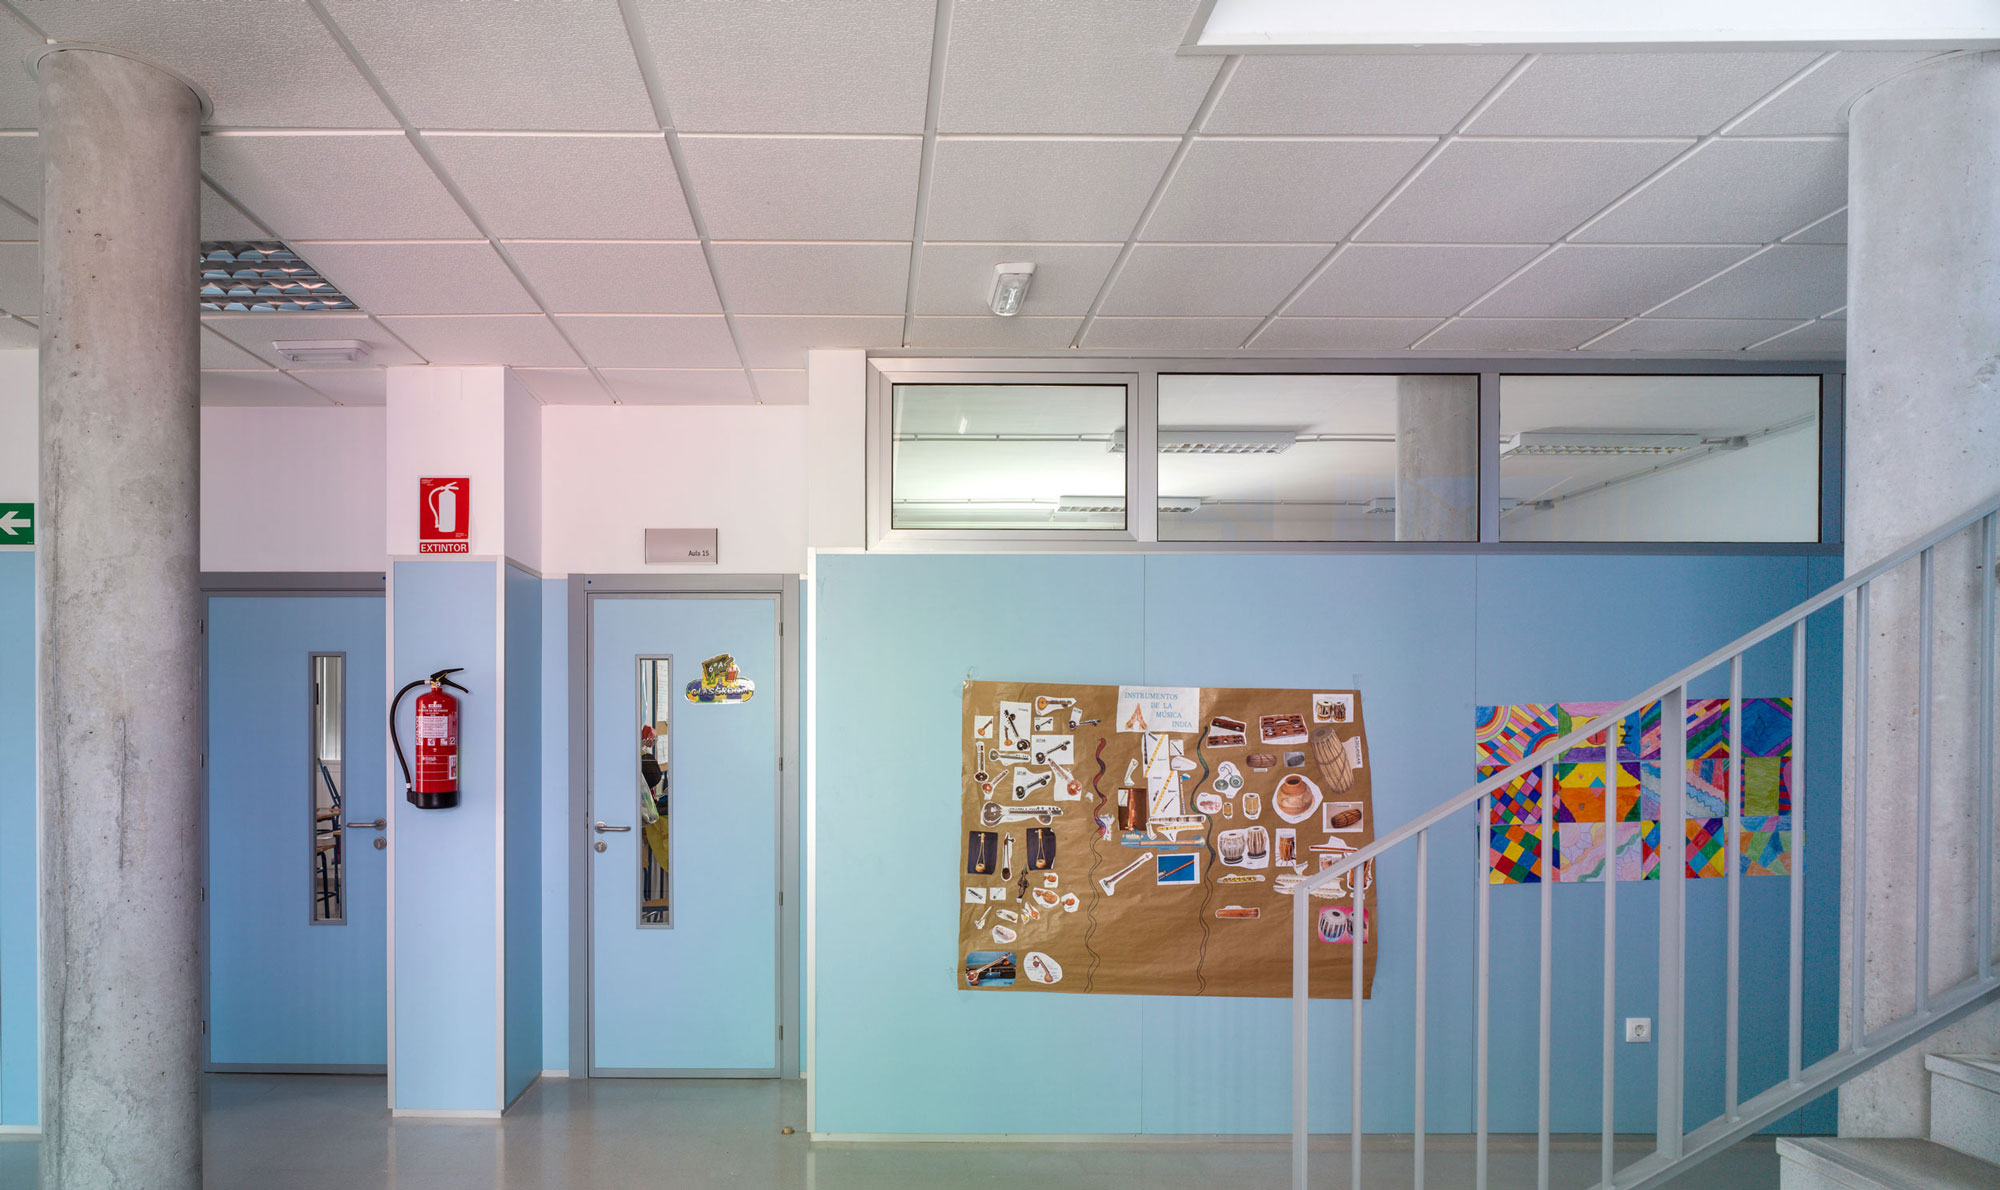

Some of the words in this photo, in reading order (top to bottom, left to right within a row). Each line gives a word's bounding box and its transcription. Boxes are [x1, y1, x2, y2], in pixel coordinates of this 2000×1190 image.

[420, 543, 467, 553] EXTINTOR
[688, 549, 701, 557] Aula
[702, 549, 710, 557] 15
[691, 685, 749, 697] CLASSROOM
[1124, 692, 1178, 700] INSTRUMENTOS
